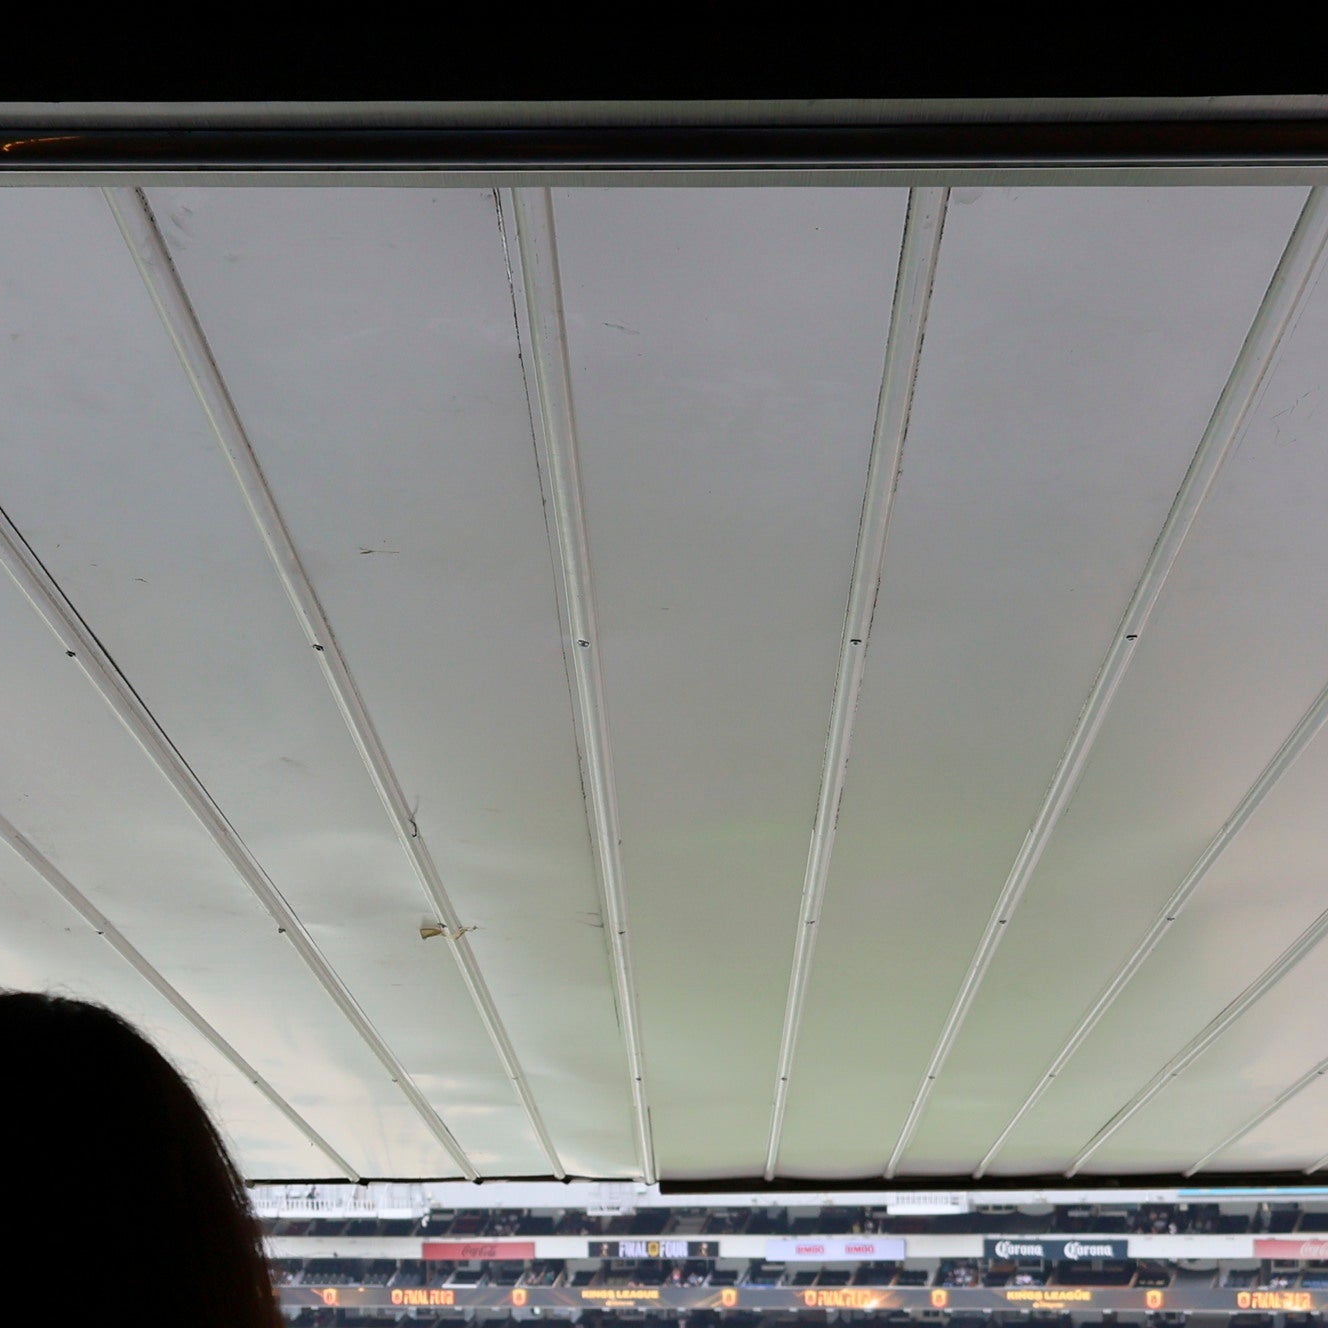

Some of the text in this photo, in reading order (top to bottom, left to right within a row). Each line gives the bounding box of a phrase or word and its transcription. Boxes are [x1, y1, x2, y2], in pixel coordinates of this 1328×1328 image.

[619, 1241, 688, 1258] FINAL FOUR
[995, 1241, 1043, 1259] Corona
[1064, 1242, 1114, 1260] Corona
[581, 1289, 660, 1299] KINGS LEAGUE
[1006, 1290, 1091, 1302] KINGS LEAGUE
